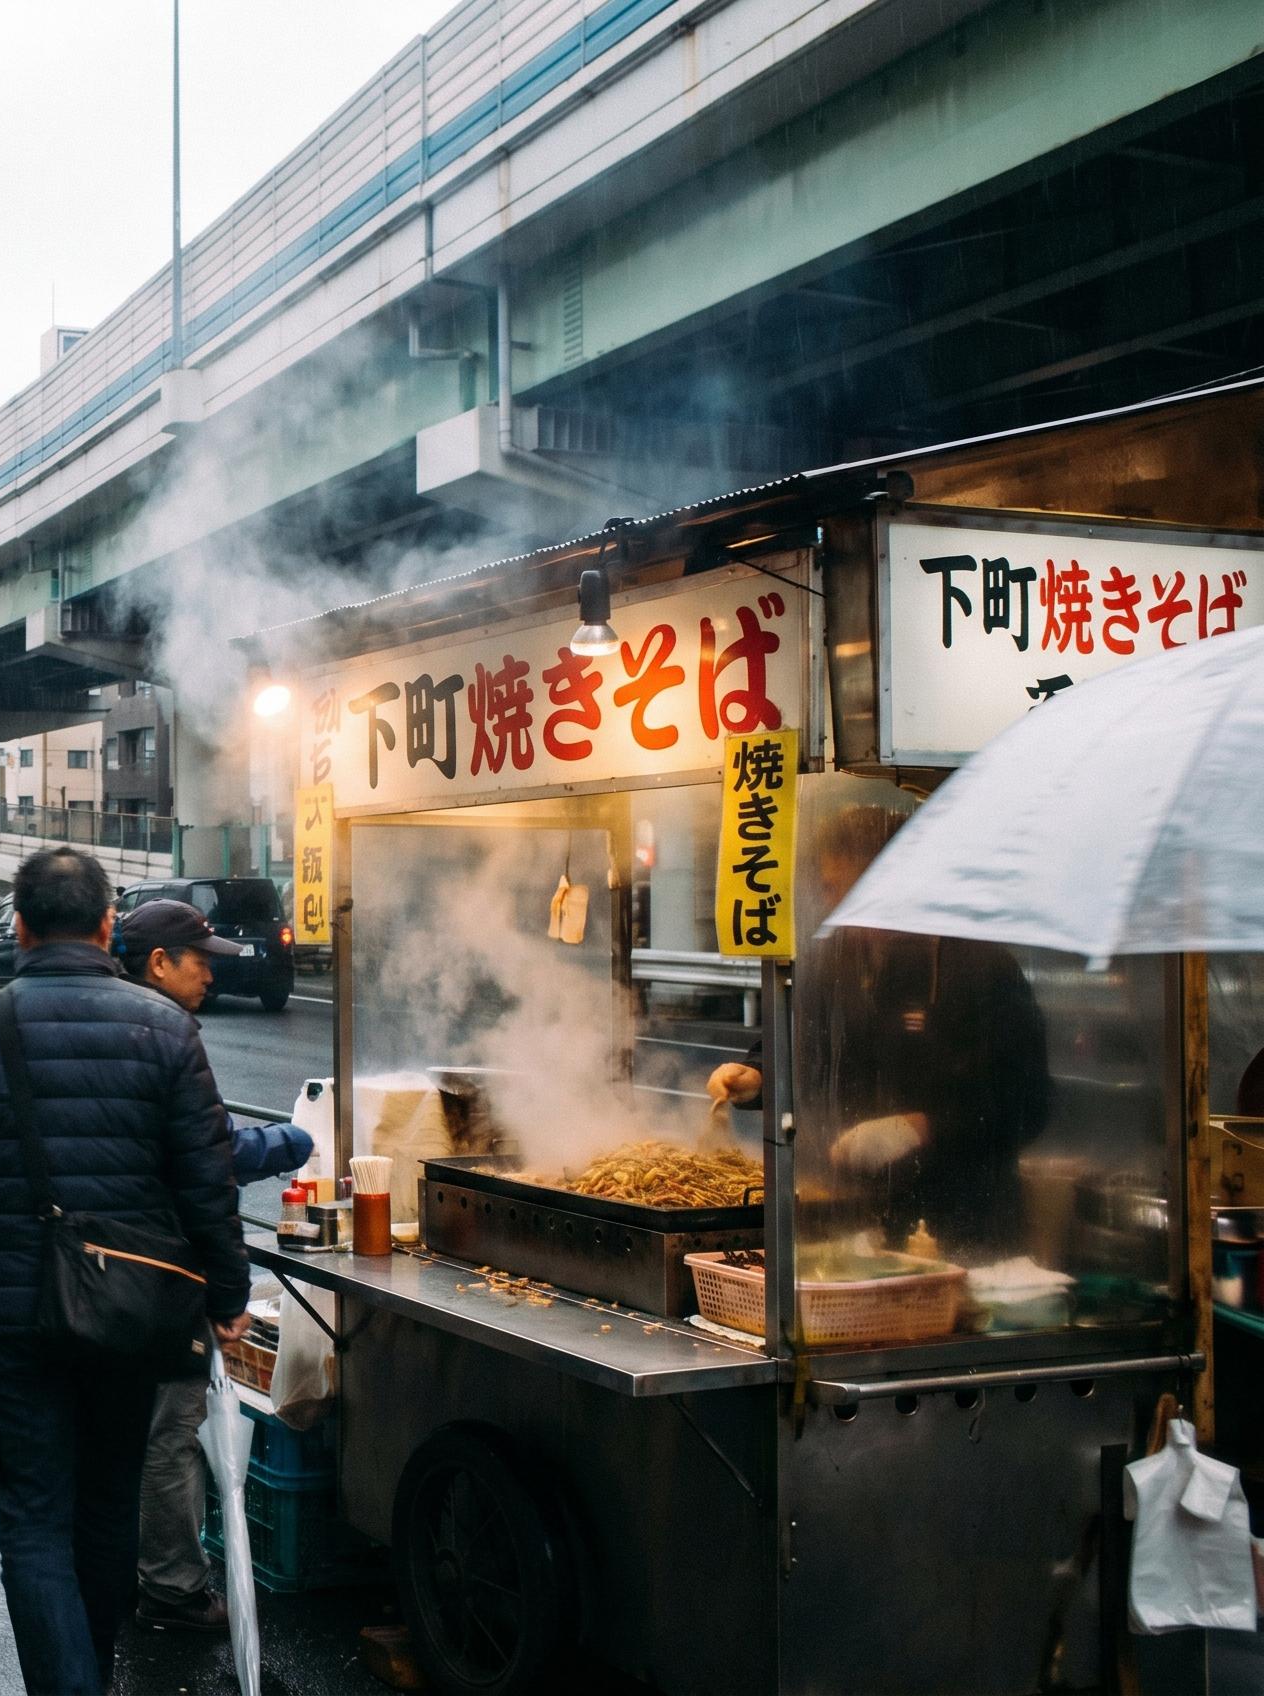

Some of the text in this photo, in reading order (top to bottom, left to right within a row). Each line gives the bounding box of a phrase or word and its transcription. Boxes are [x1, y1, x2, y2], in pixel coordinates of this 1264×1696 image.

[348, 591, 786, 789] 下町焼きそば
[919, 553, 1248, 656] 下町焼きそば
[733, 738, 784, 948] 焼きそば
